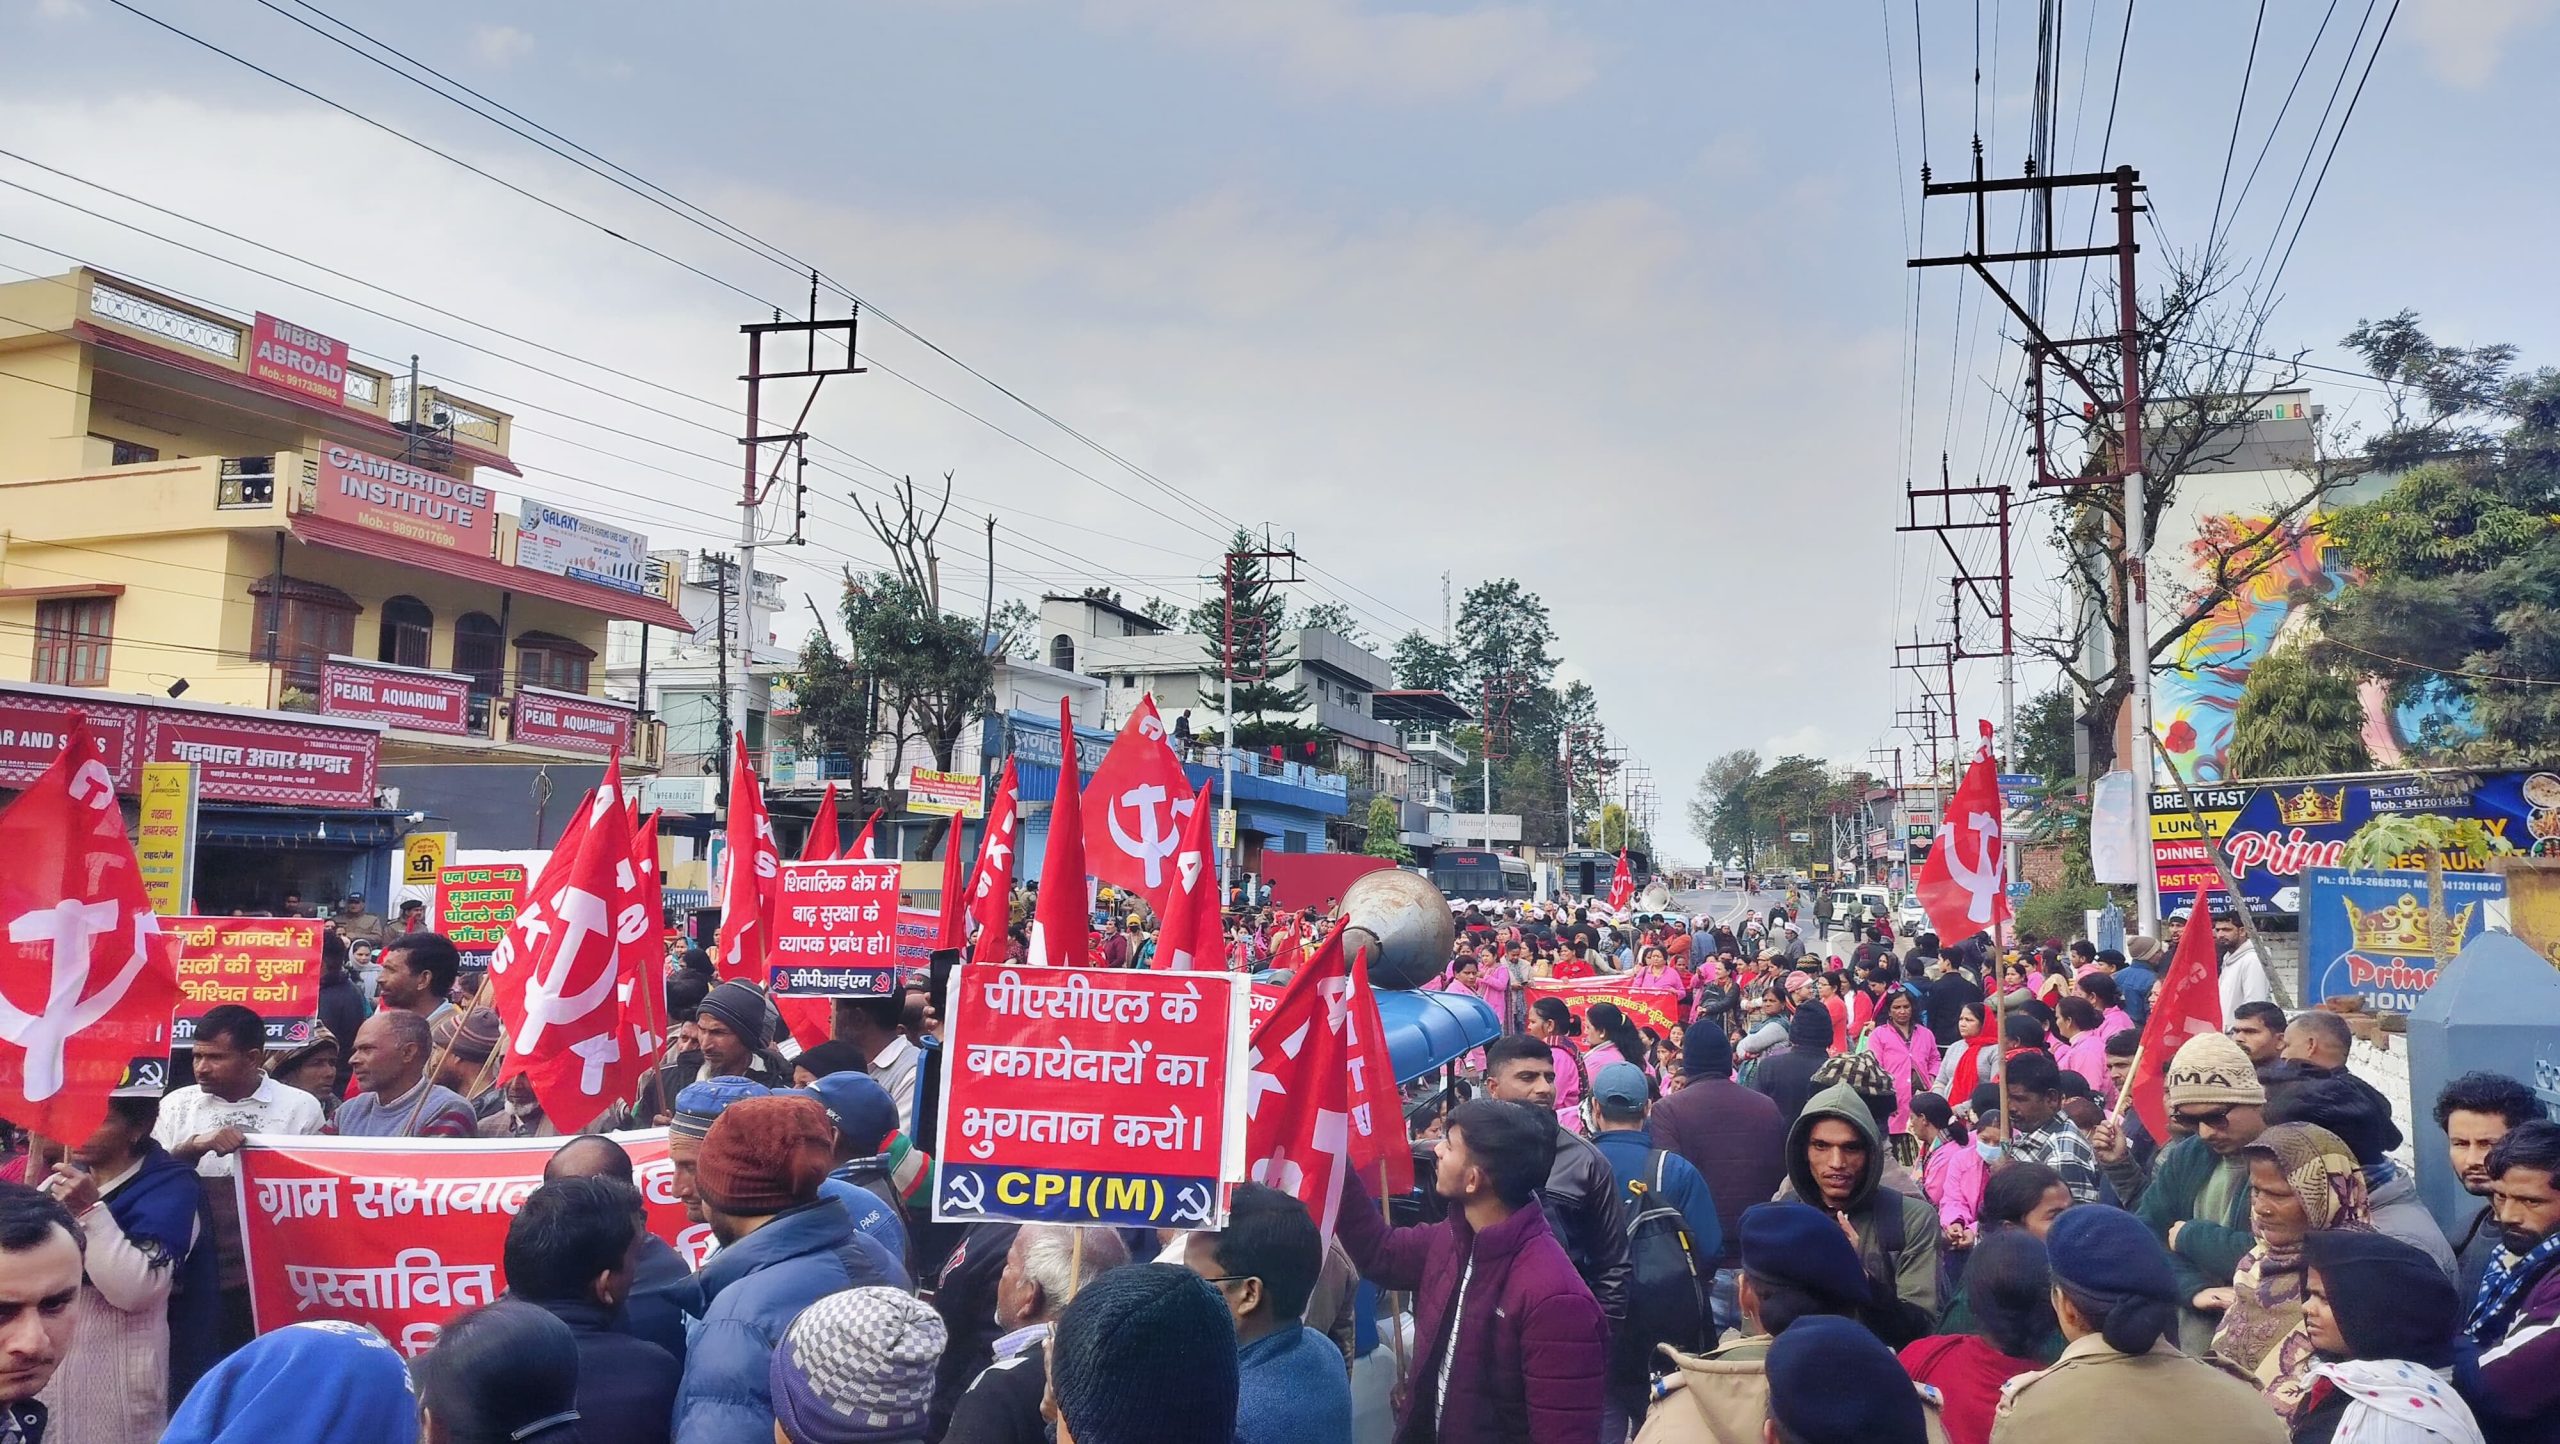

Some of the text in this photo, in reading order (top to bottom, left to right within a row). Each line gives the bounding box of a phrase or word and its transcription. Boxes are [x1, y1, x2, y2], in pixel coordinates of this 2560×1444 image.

[274, 320, 332, 356] MBBS
[257, 341, 342, 383] ABROAD
[2225, 409, 2273, 421] KCHEN
[328, 447, 487, 509] CAMBRIDGE
[340, 474, 473, 528] INSTITUTE
[358, 512, 455, 547] Mob.: 9897017690
[542, 509, 579, 532] GALAXY
[334, 682, 448, 711] PEARL AQUARIUM
[525, 709, 615, 735] PEARL AQUARIUM
[19, 731, 54, 749] AND
[58, 733, 106, 753] SS
[246, 748, 297, 769] अचार
[299, 752, 352, 774] भण्डार
[915, 768, 940, 781] DOG
[943, 772, 979, 785] SHOW
[2153, 790, 2246, 810] BREK FAST
[2369, 788, 2391, 797] Ph.:
[2371, 801, 2402, 811] Mob.:
[1910, 815, 1930, 823] HOTEL
[1910, 825, 1931, 835] BAR
[412, 855, 435, 872] घी
[443, 871, 464, 883] एन
[468, 870, 490, 883] एच
[784, 868, 899, 893] शिवालिक क्षेत्र में
[2160, 873, 2219, 886] FAST FOD
[2317, 875, 2336, 885] Ph.:
[449, 889, 513, 908] मुआवजा
[2205, 896, 2224, 904] ome
[2225, 895, 2260, 904] Dvery
[444, 906, 517, 921] घोटाले की
[792, 900, 881, 931] बाढ़ सुरक्षा के
[221, 927, 296, 947] जानवरों
[296, 927, 315, 948] से
[449, 926, 485, 941] जाँच
[779, 936, 826, 954] व्यापक
[829, 931, 864, 956] प्रबंध
[179, 953, 306, 982] सलों की सुरक्षा
[790, 968, 872, 989] सीपीआईएम
[2345, 954, 2440, 991] Princ
[984, 969, 1154, 1023] पीएसीएल
[1160, 981, 1202, 1024] के
[2358, 991, 2423, 1010] HON
[966, 1036, 1209, 1088] बकायेदारों का
[961, 1104, 1203, 1160] भुगतान करो।
[254, 1176, 340, 1225] ग्राम
[995, 1171, 1166, 1222] CPI(M)
[285, 1247, 496, 1313] प्रस्तावित
